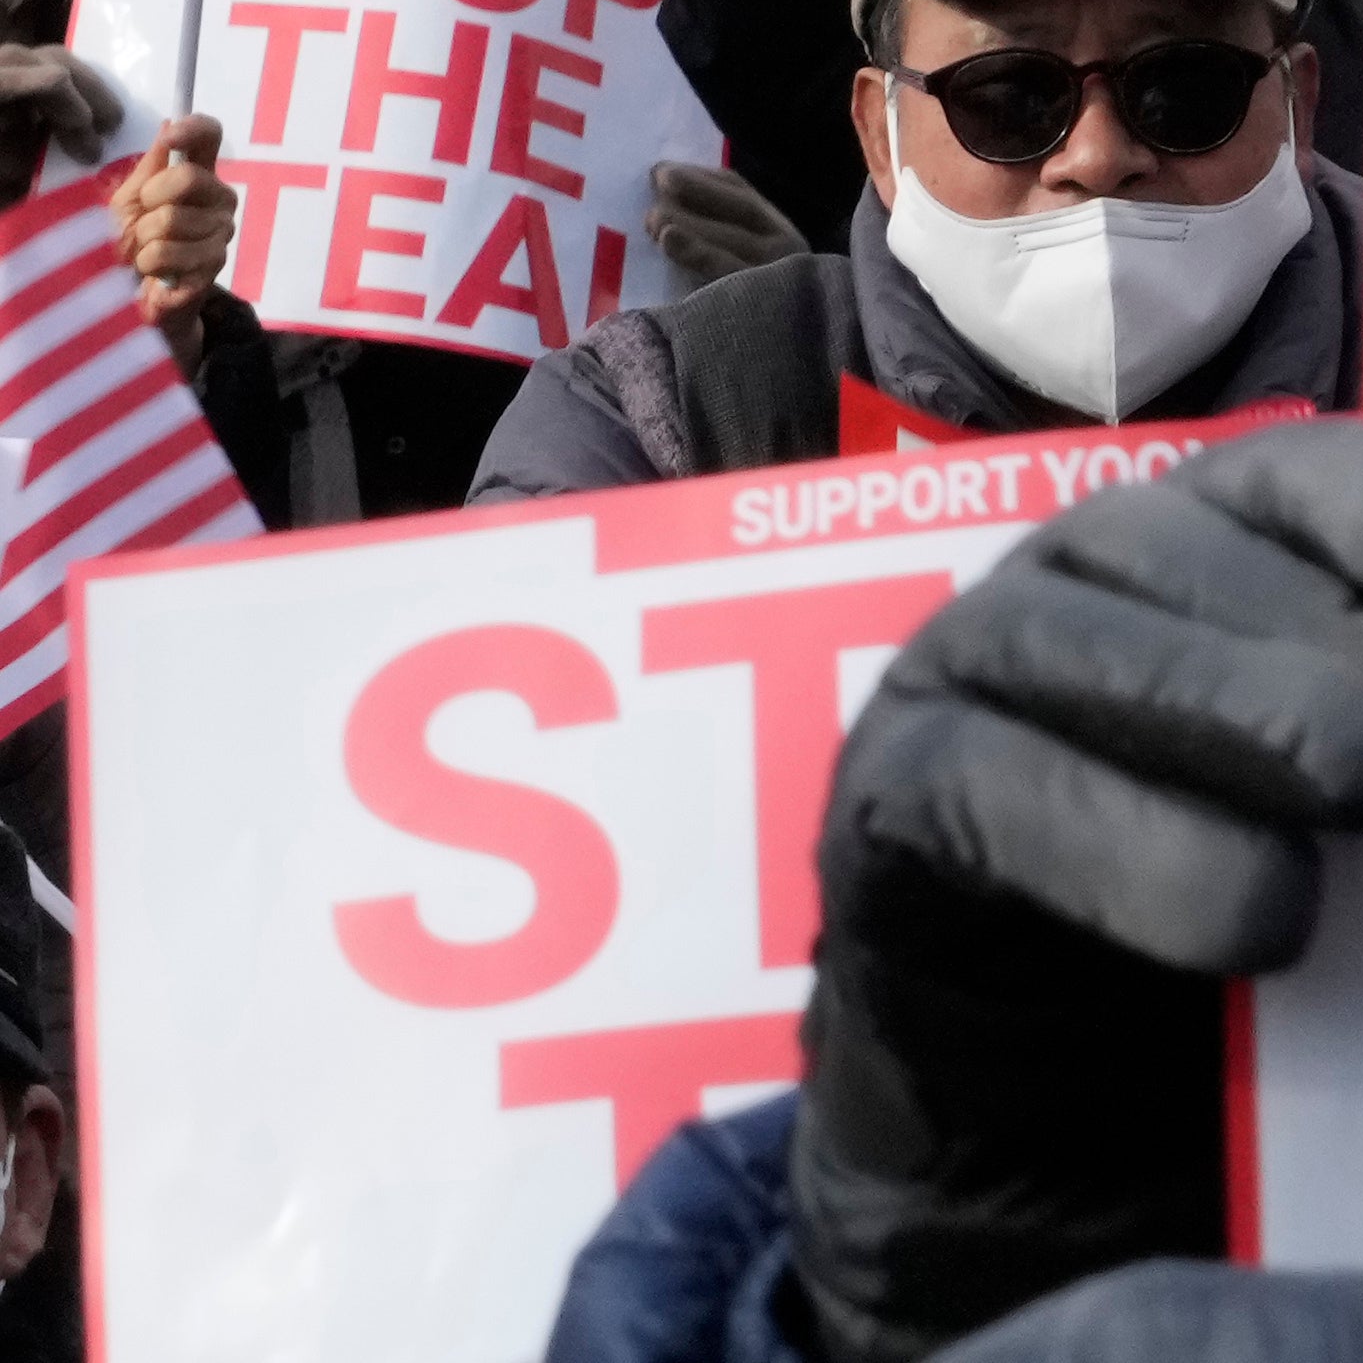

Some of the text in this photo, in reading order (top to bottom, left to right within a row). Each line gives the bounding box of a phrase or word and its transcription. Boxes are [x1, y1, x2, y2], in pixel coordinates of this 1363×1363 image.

[229, 2, 603, 200] THE
[732, 453, 1031, 545] SUPPORT
[333, 566, 956, 1010] ST
